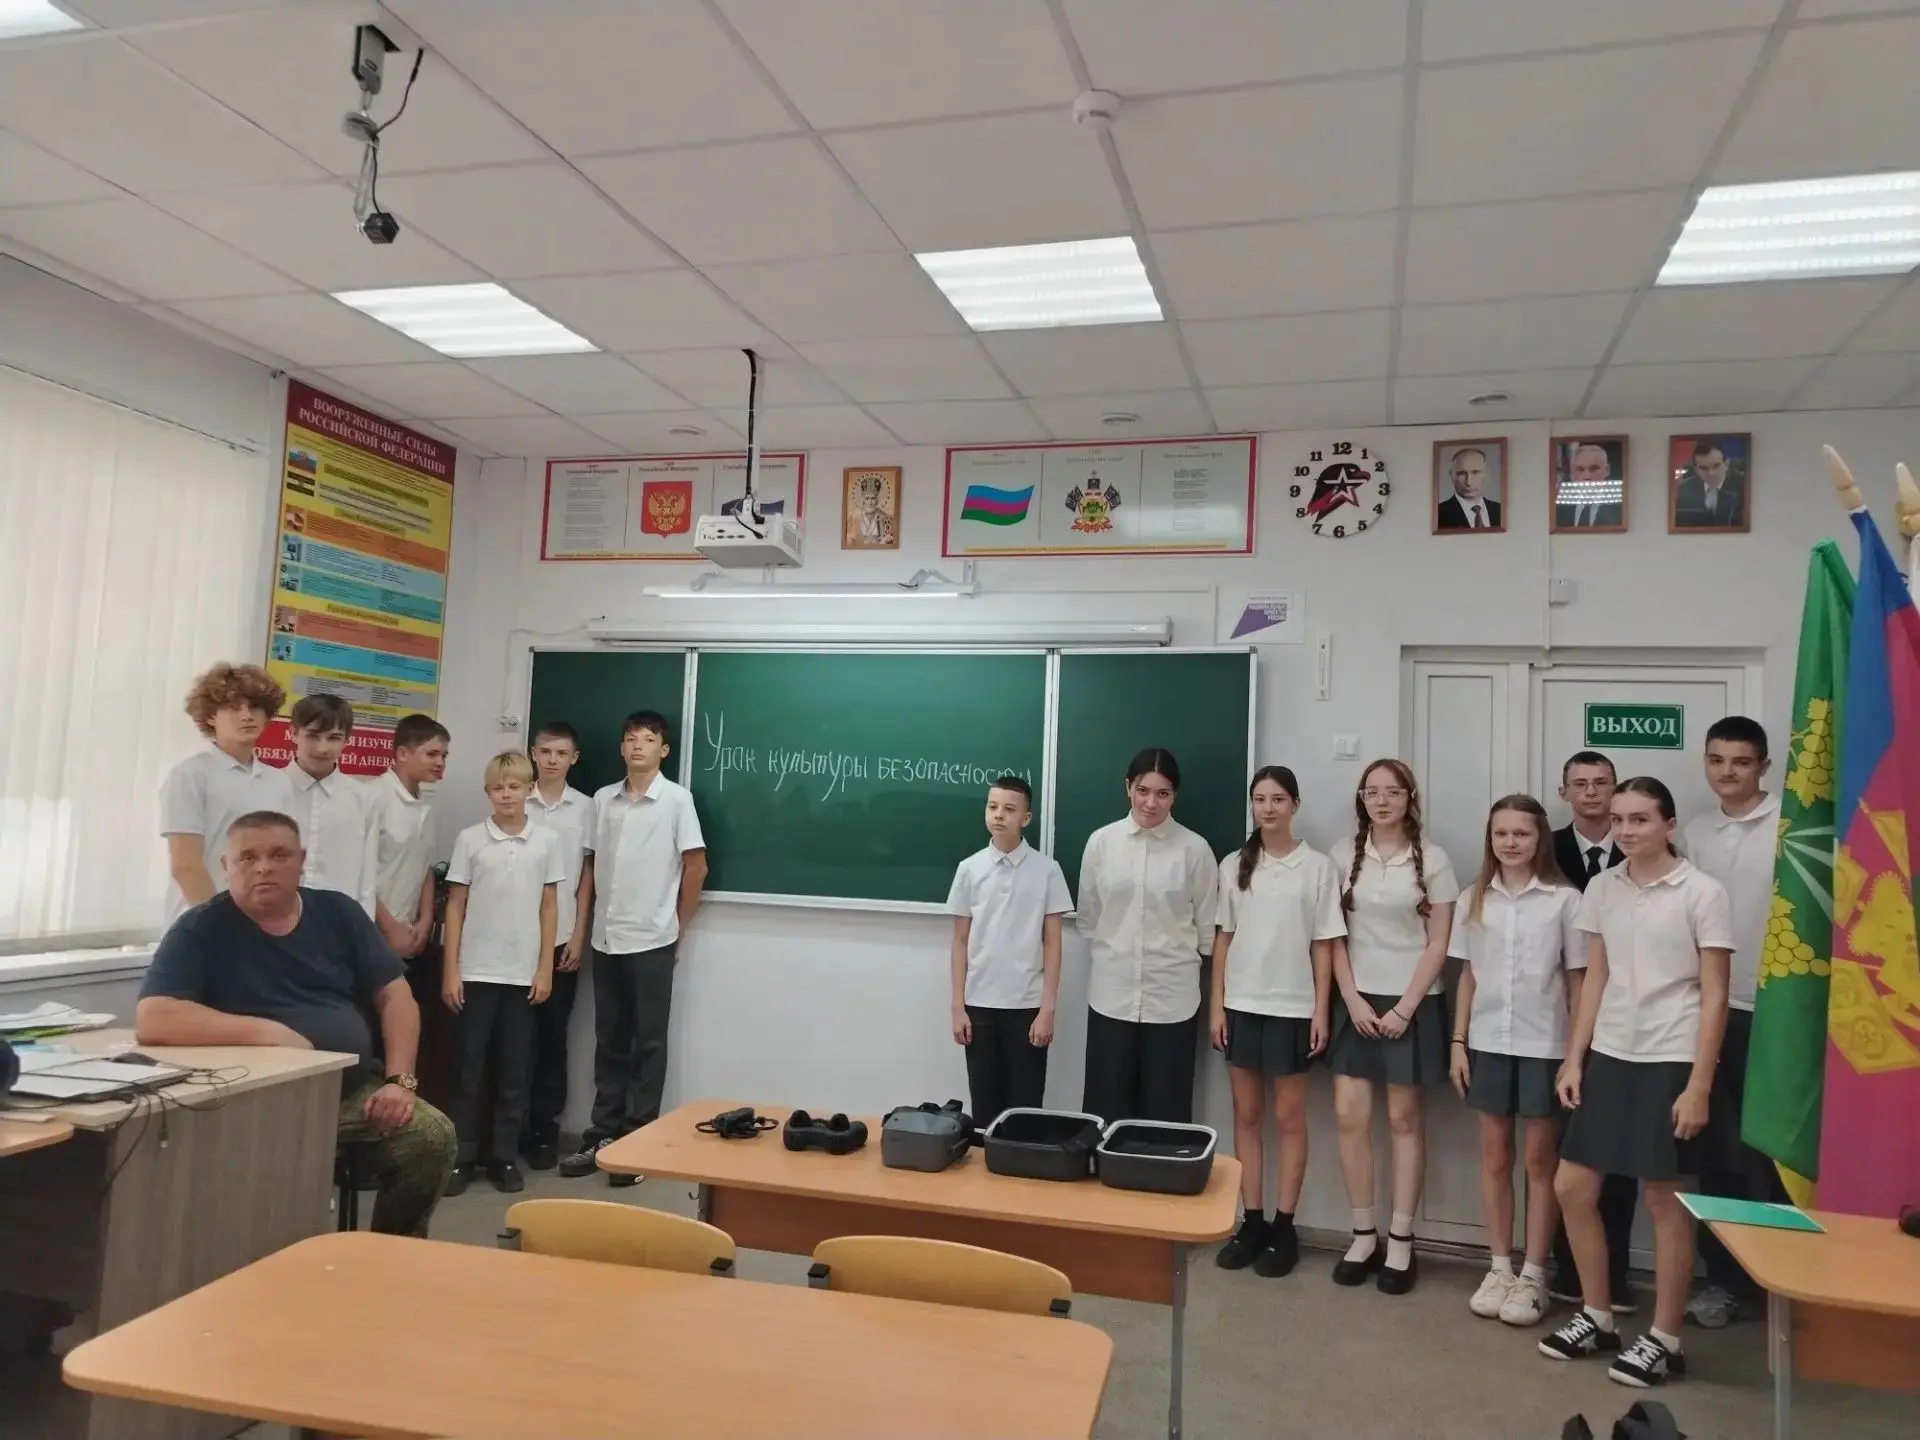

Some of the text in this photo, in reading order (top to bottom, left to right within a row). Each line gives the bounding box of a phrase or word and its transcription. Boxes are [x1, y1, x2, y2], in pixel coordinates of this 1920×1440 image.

[313, 397, 437, 457] ВООРУЖЕННЫЕ СИЛЫ
[299, 407, 379, 449] РОССИЙСКОЙ
[381, 440, 446, 475] ФЕДЕРАЦИИ
[1332, 442, 1352, 455] 12
[1361, 448, 1368, 459] 1
[1310, 451, 1323, 461] 11
[1294, 466, 1310, 477] 10
[1375, 461, 1385, 472] 2
[1289, 485, 1301, 498] 9
[1378, 483, 1390, 496] 3
[1296, 508, 1305, 518] 8
[1373, 504, 1383, 514] 4
[1312, 524, 1322, 534] 7
[1358, 520, 1367, 531] 5
[1333, 526, 1345, 539] 6
[1592, 716, 1677, 738] ВЫХОД
[704, 711, 758, 792] Урок
[768, 747, 868, 802] культуры
